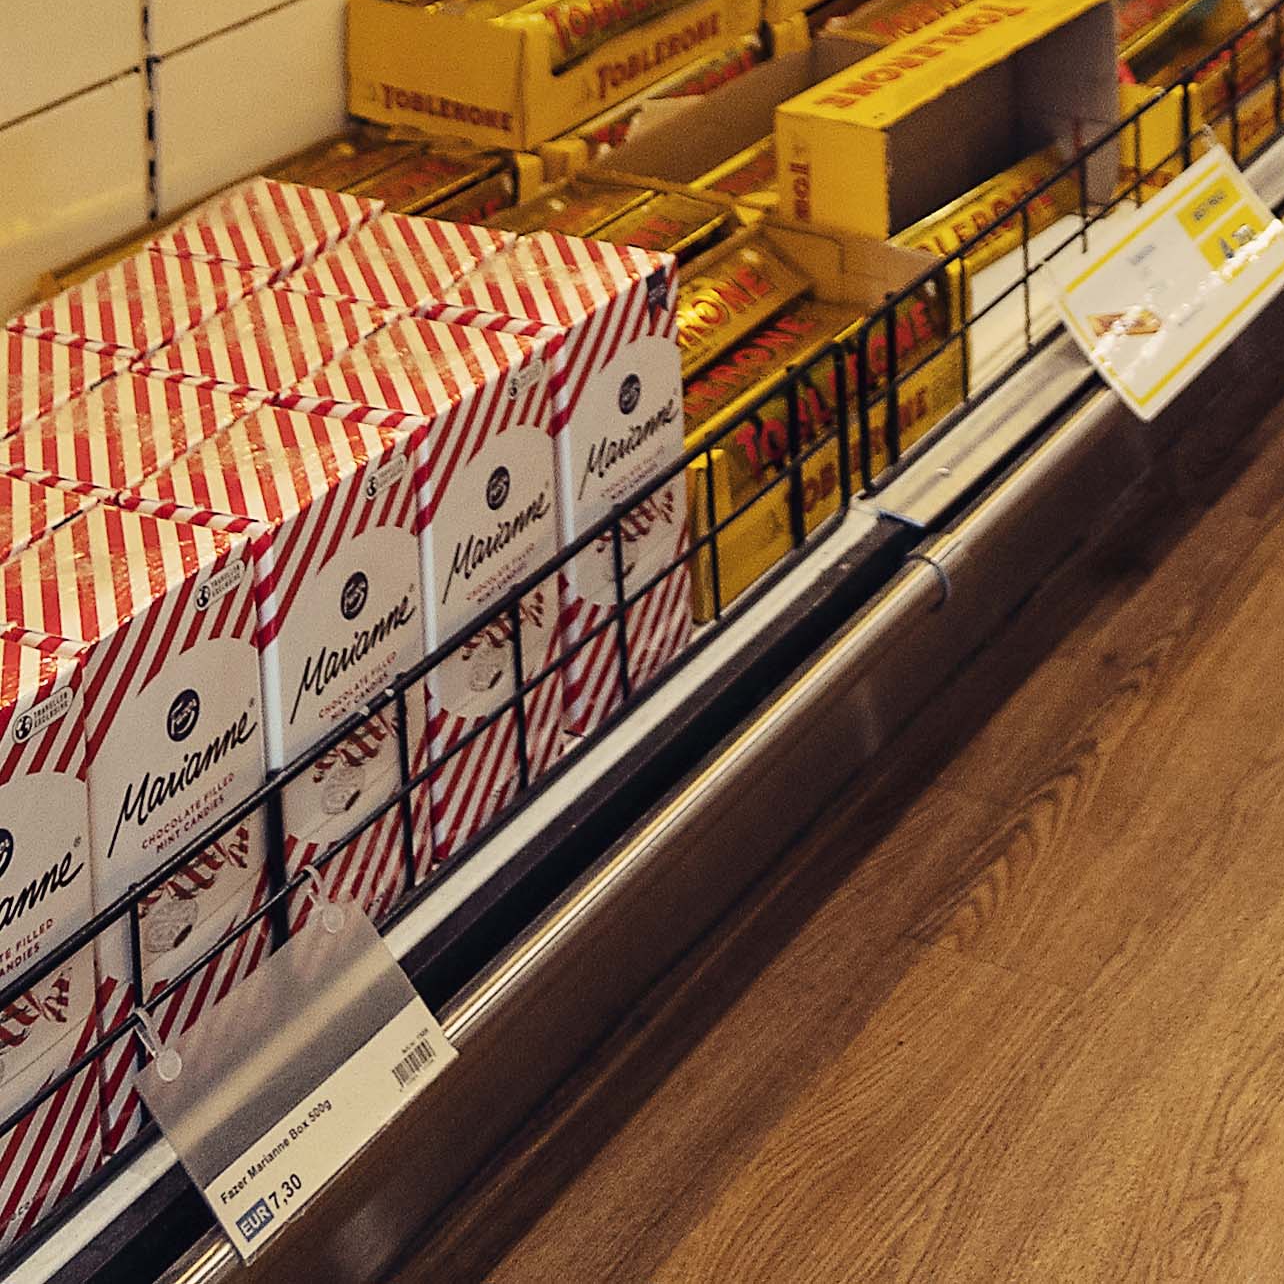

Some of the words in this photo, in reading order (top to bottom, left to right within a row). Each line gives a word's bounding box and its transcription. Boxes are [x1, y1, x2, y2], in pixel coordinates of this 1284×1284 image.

[442, 491, 551, 605] Marianne
[290, 595, 416, 724] Marianne
[107, 710, 258, 858] Marianne
[142, 799, 201, 850] CHOCOLATE
[203, 772, 235, 802] FILLED
[156, 829, 180, 854] MINT
[184, 794, 224, 832] CANDIES
[16, 918, 54, 952] FILLED
[220, 1176, 249, 1205] Fazer
[247, 1137, 290, 1181] Marianne
[288, 1120, 311, 1142] Box
[308, 1099, 332, 1123] 500g
[239, 1205, 272, 1237] EUR
[268, 1173, 302, 1210] 7,30
